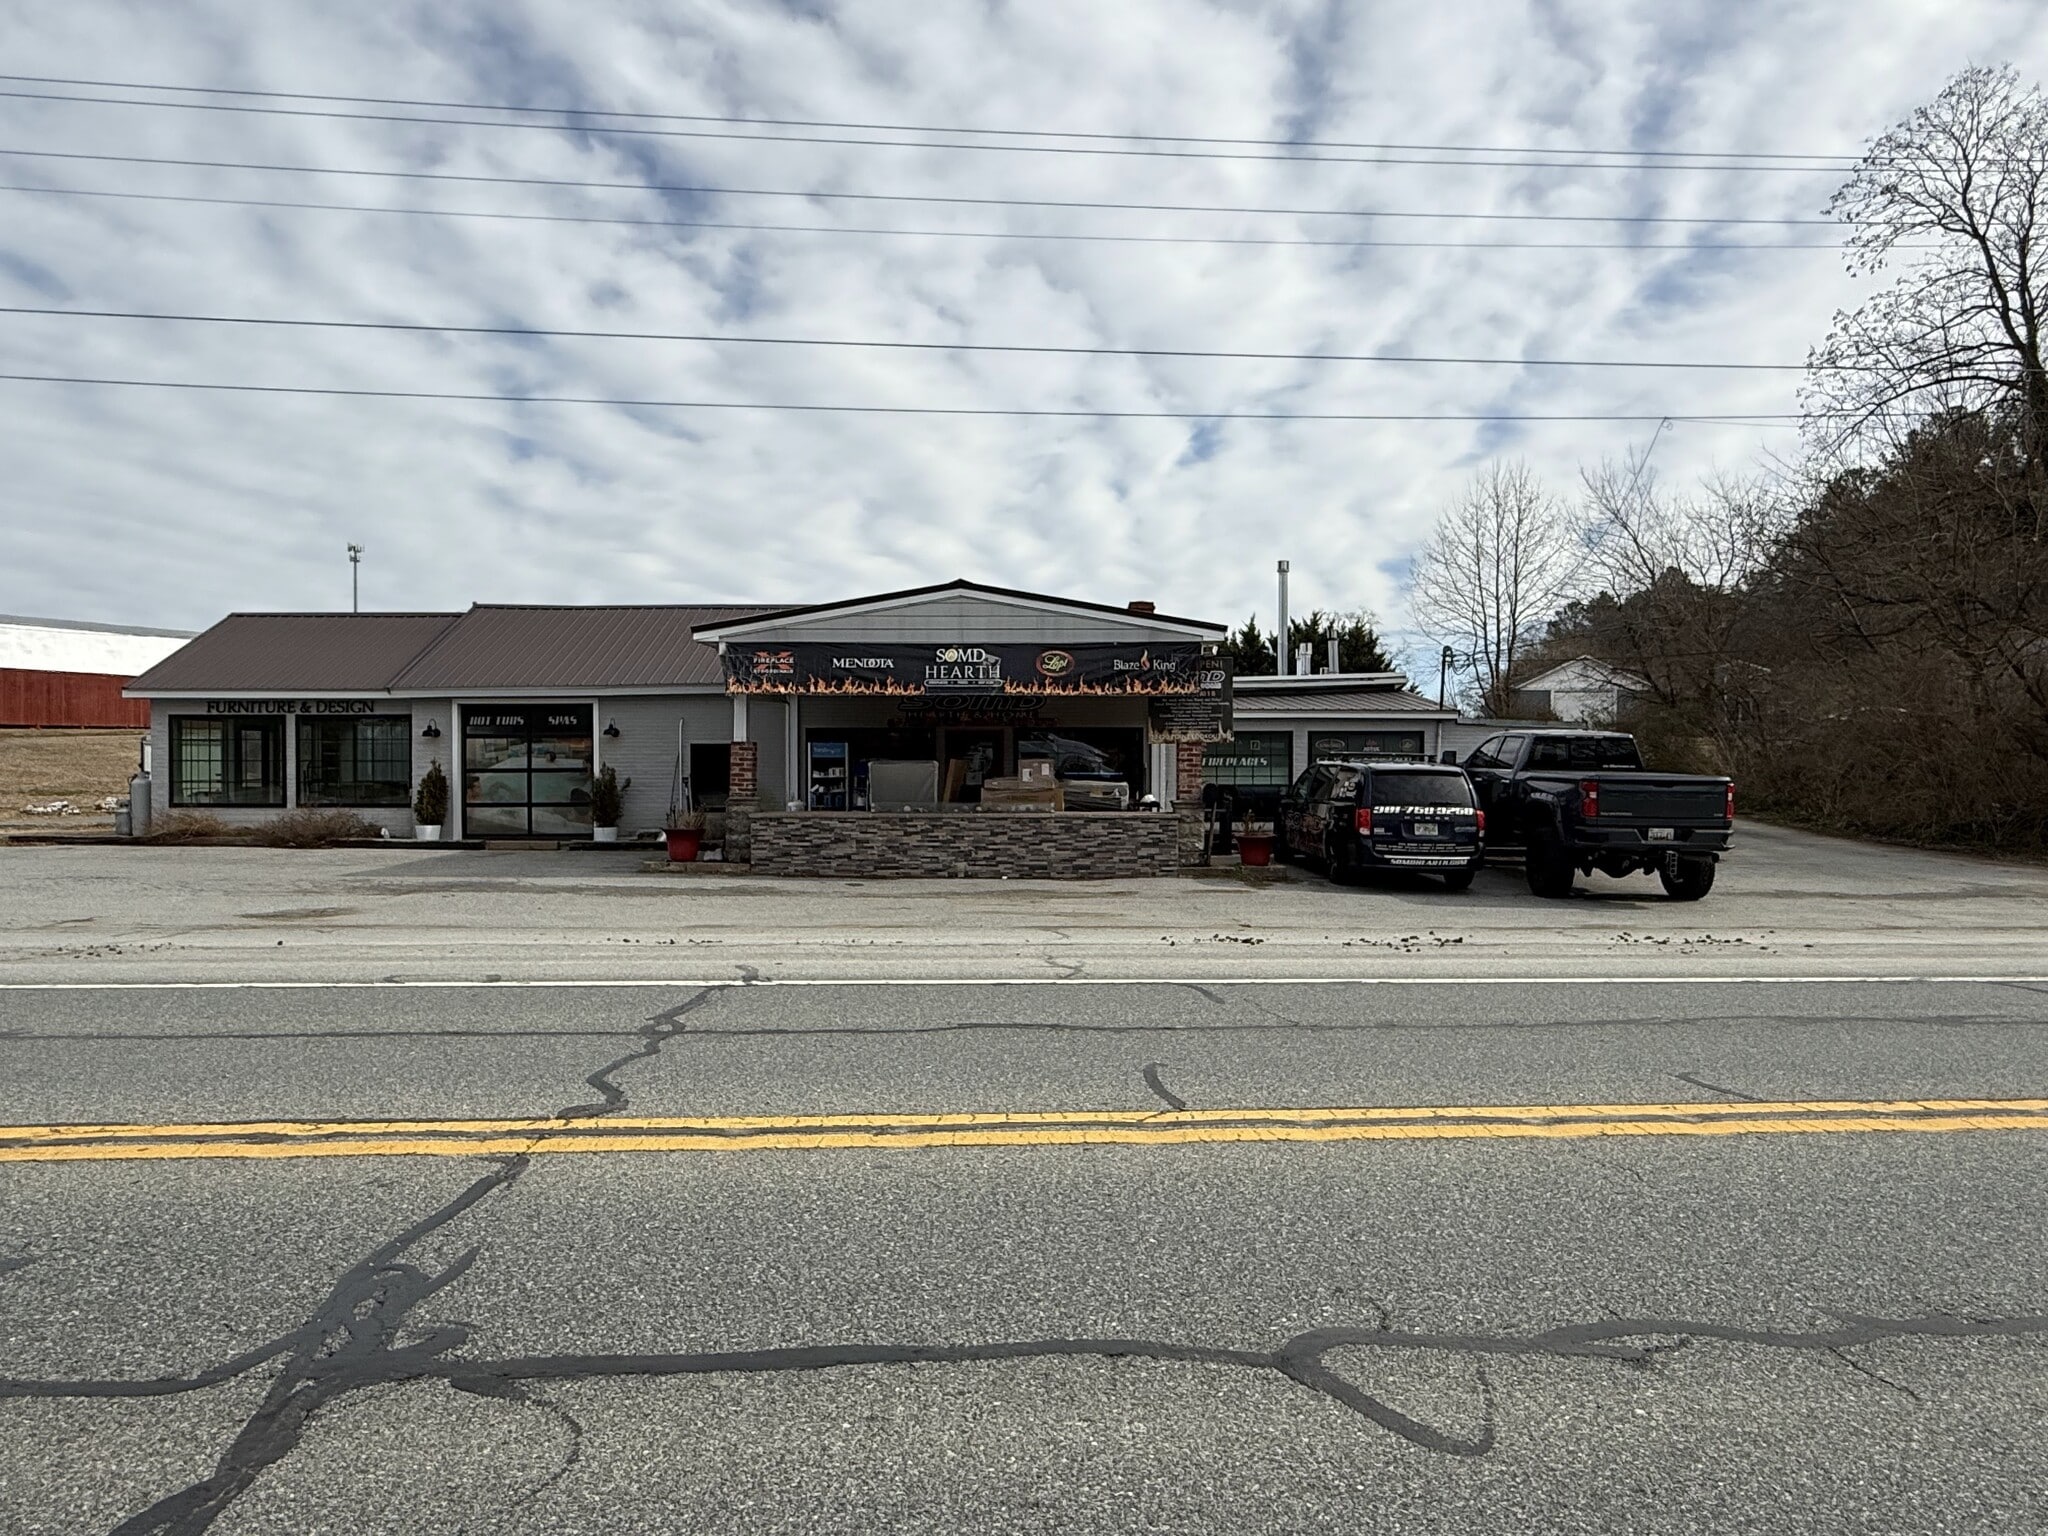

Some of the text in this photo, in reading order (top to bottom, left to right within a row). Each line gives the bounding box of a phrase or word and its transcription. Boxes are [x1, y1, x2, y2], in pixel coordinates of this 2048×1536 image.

[936, 648, 985, 662] SOMD
[832, 657, 894, 668] MENDOTA
[1113, 659, 1176, 672] Blaze King
[925, 665, 1001, 679] HEARTH
[206, 700, 375, 713] FURNITURE & DESIGN
[469, 716, 577, 725] HOT TUBS SPAS
[1202, 757, 1267, 766] FIREPLACES
